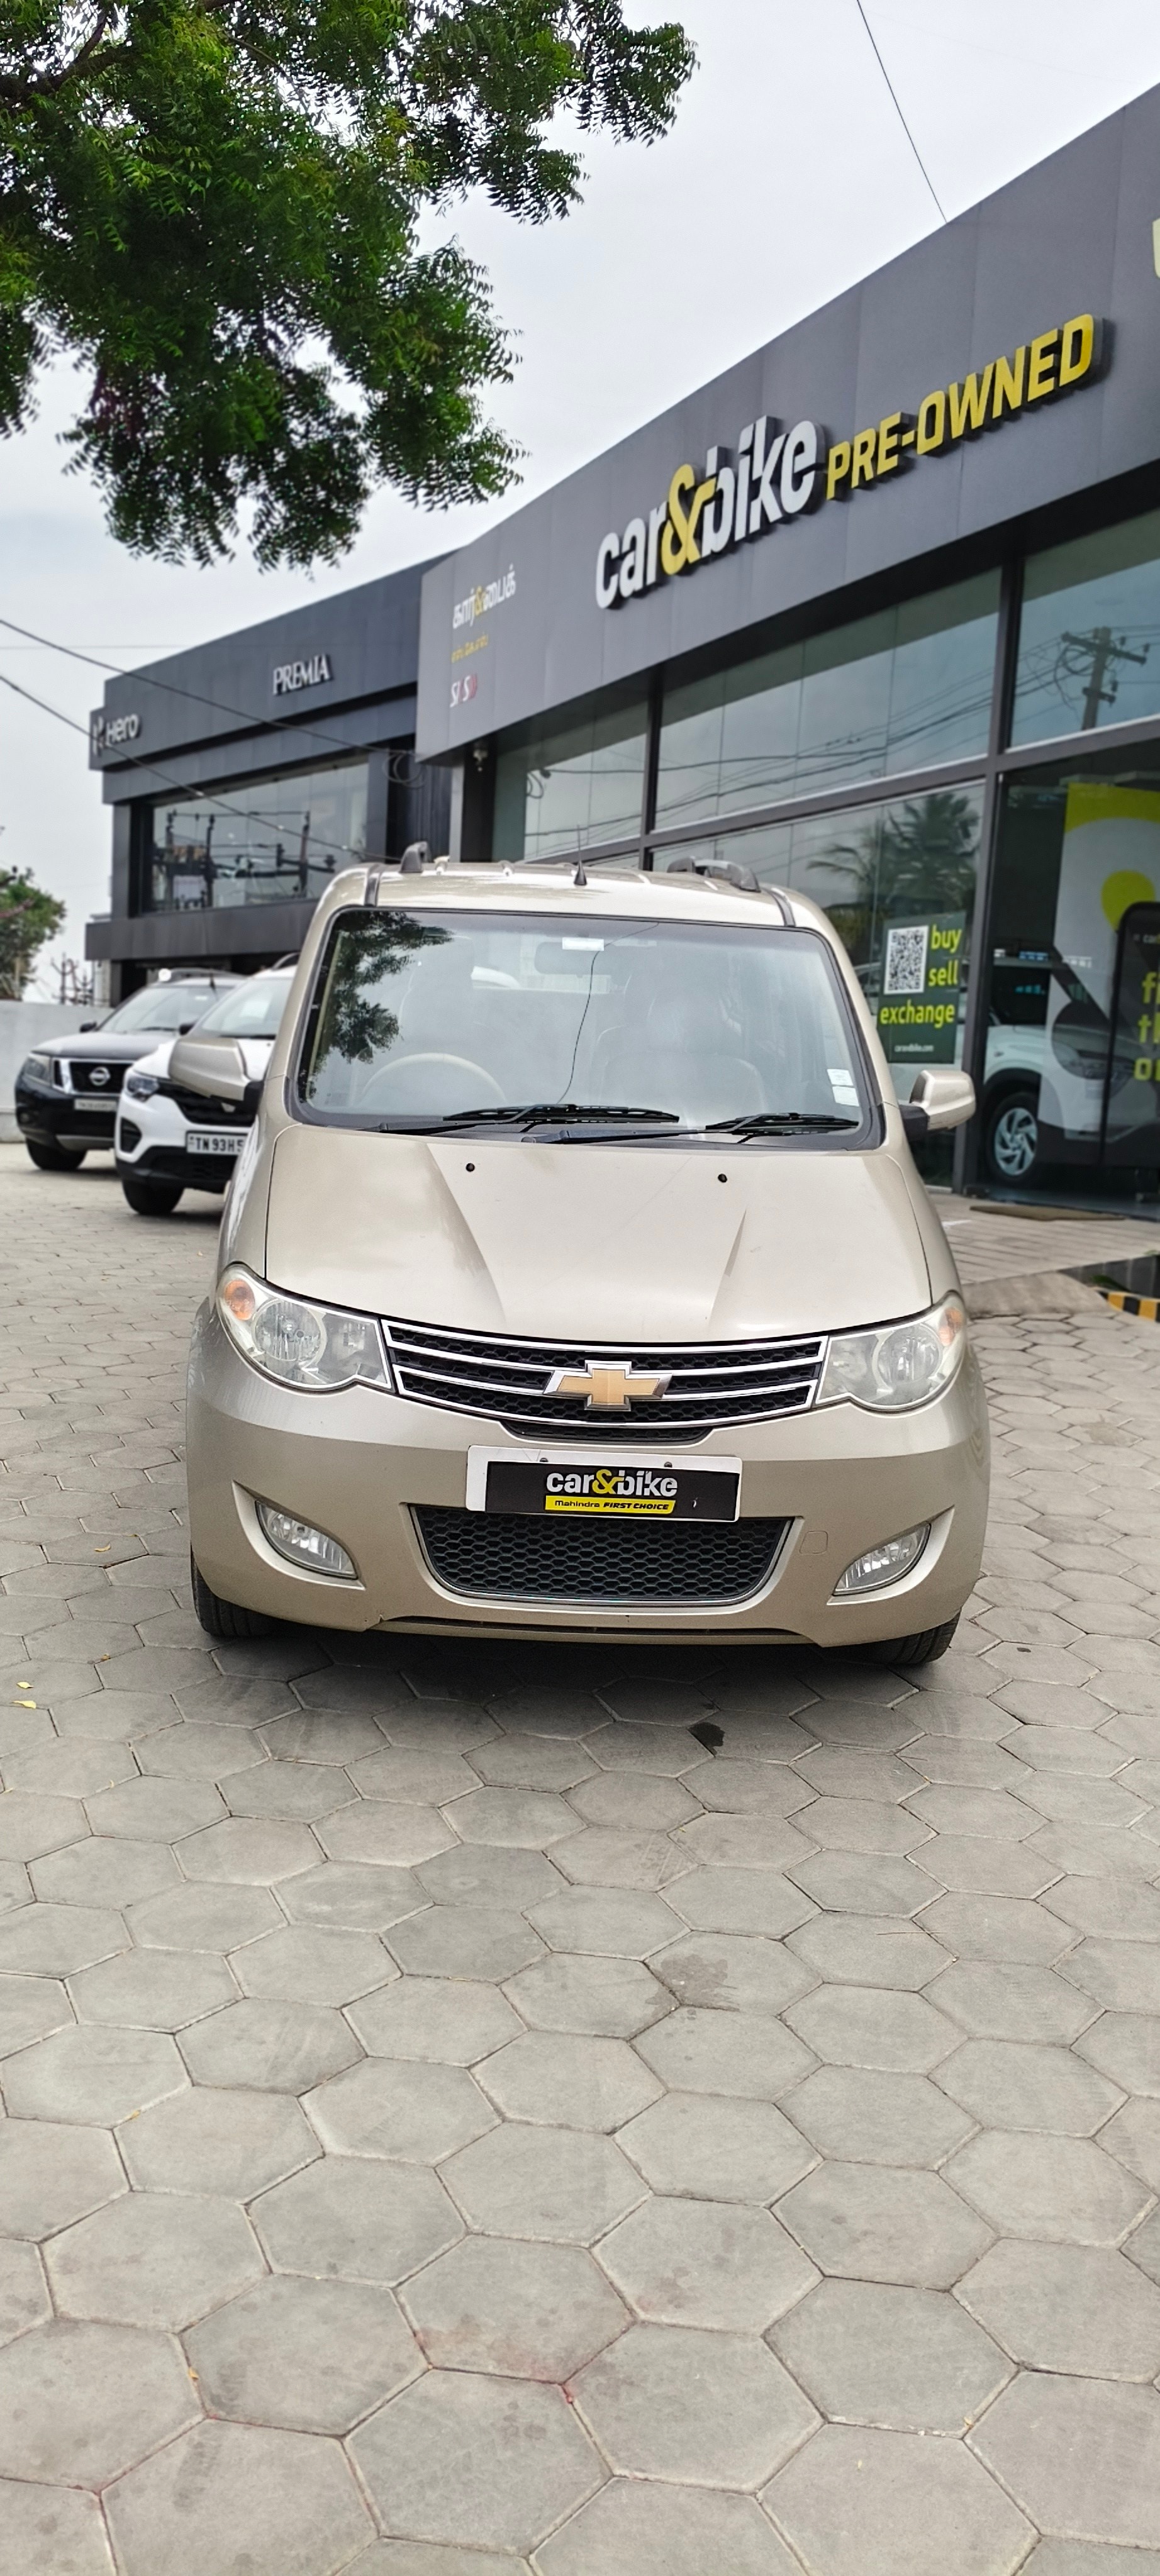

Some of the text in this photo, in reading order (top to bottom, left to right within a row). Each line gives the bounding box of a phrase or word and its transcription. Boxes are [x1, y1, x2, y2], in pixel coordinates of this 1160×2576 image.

[596, 313, 1095, 610] car&bike PRE-OWNED
[272, 653, 330, 696] PREMIA
[106, 714, 140, 748] Hero
[930, 924, 962, 953] buy
[928, 960, 959, 987] sell
[879, 999, 956, 1029] exchange
[196, 1137, 209, 1151] TN
[546, 1468, 678, 1497] car&bike
[554, 1500, 600, 1508] Mahindra
